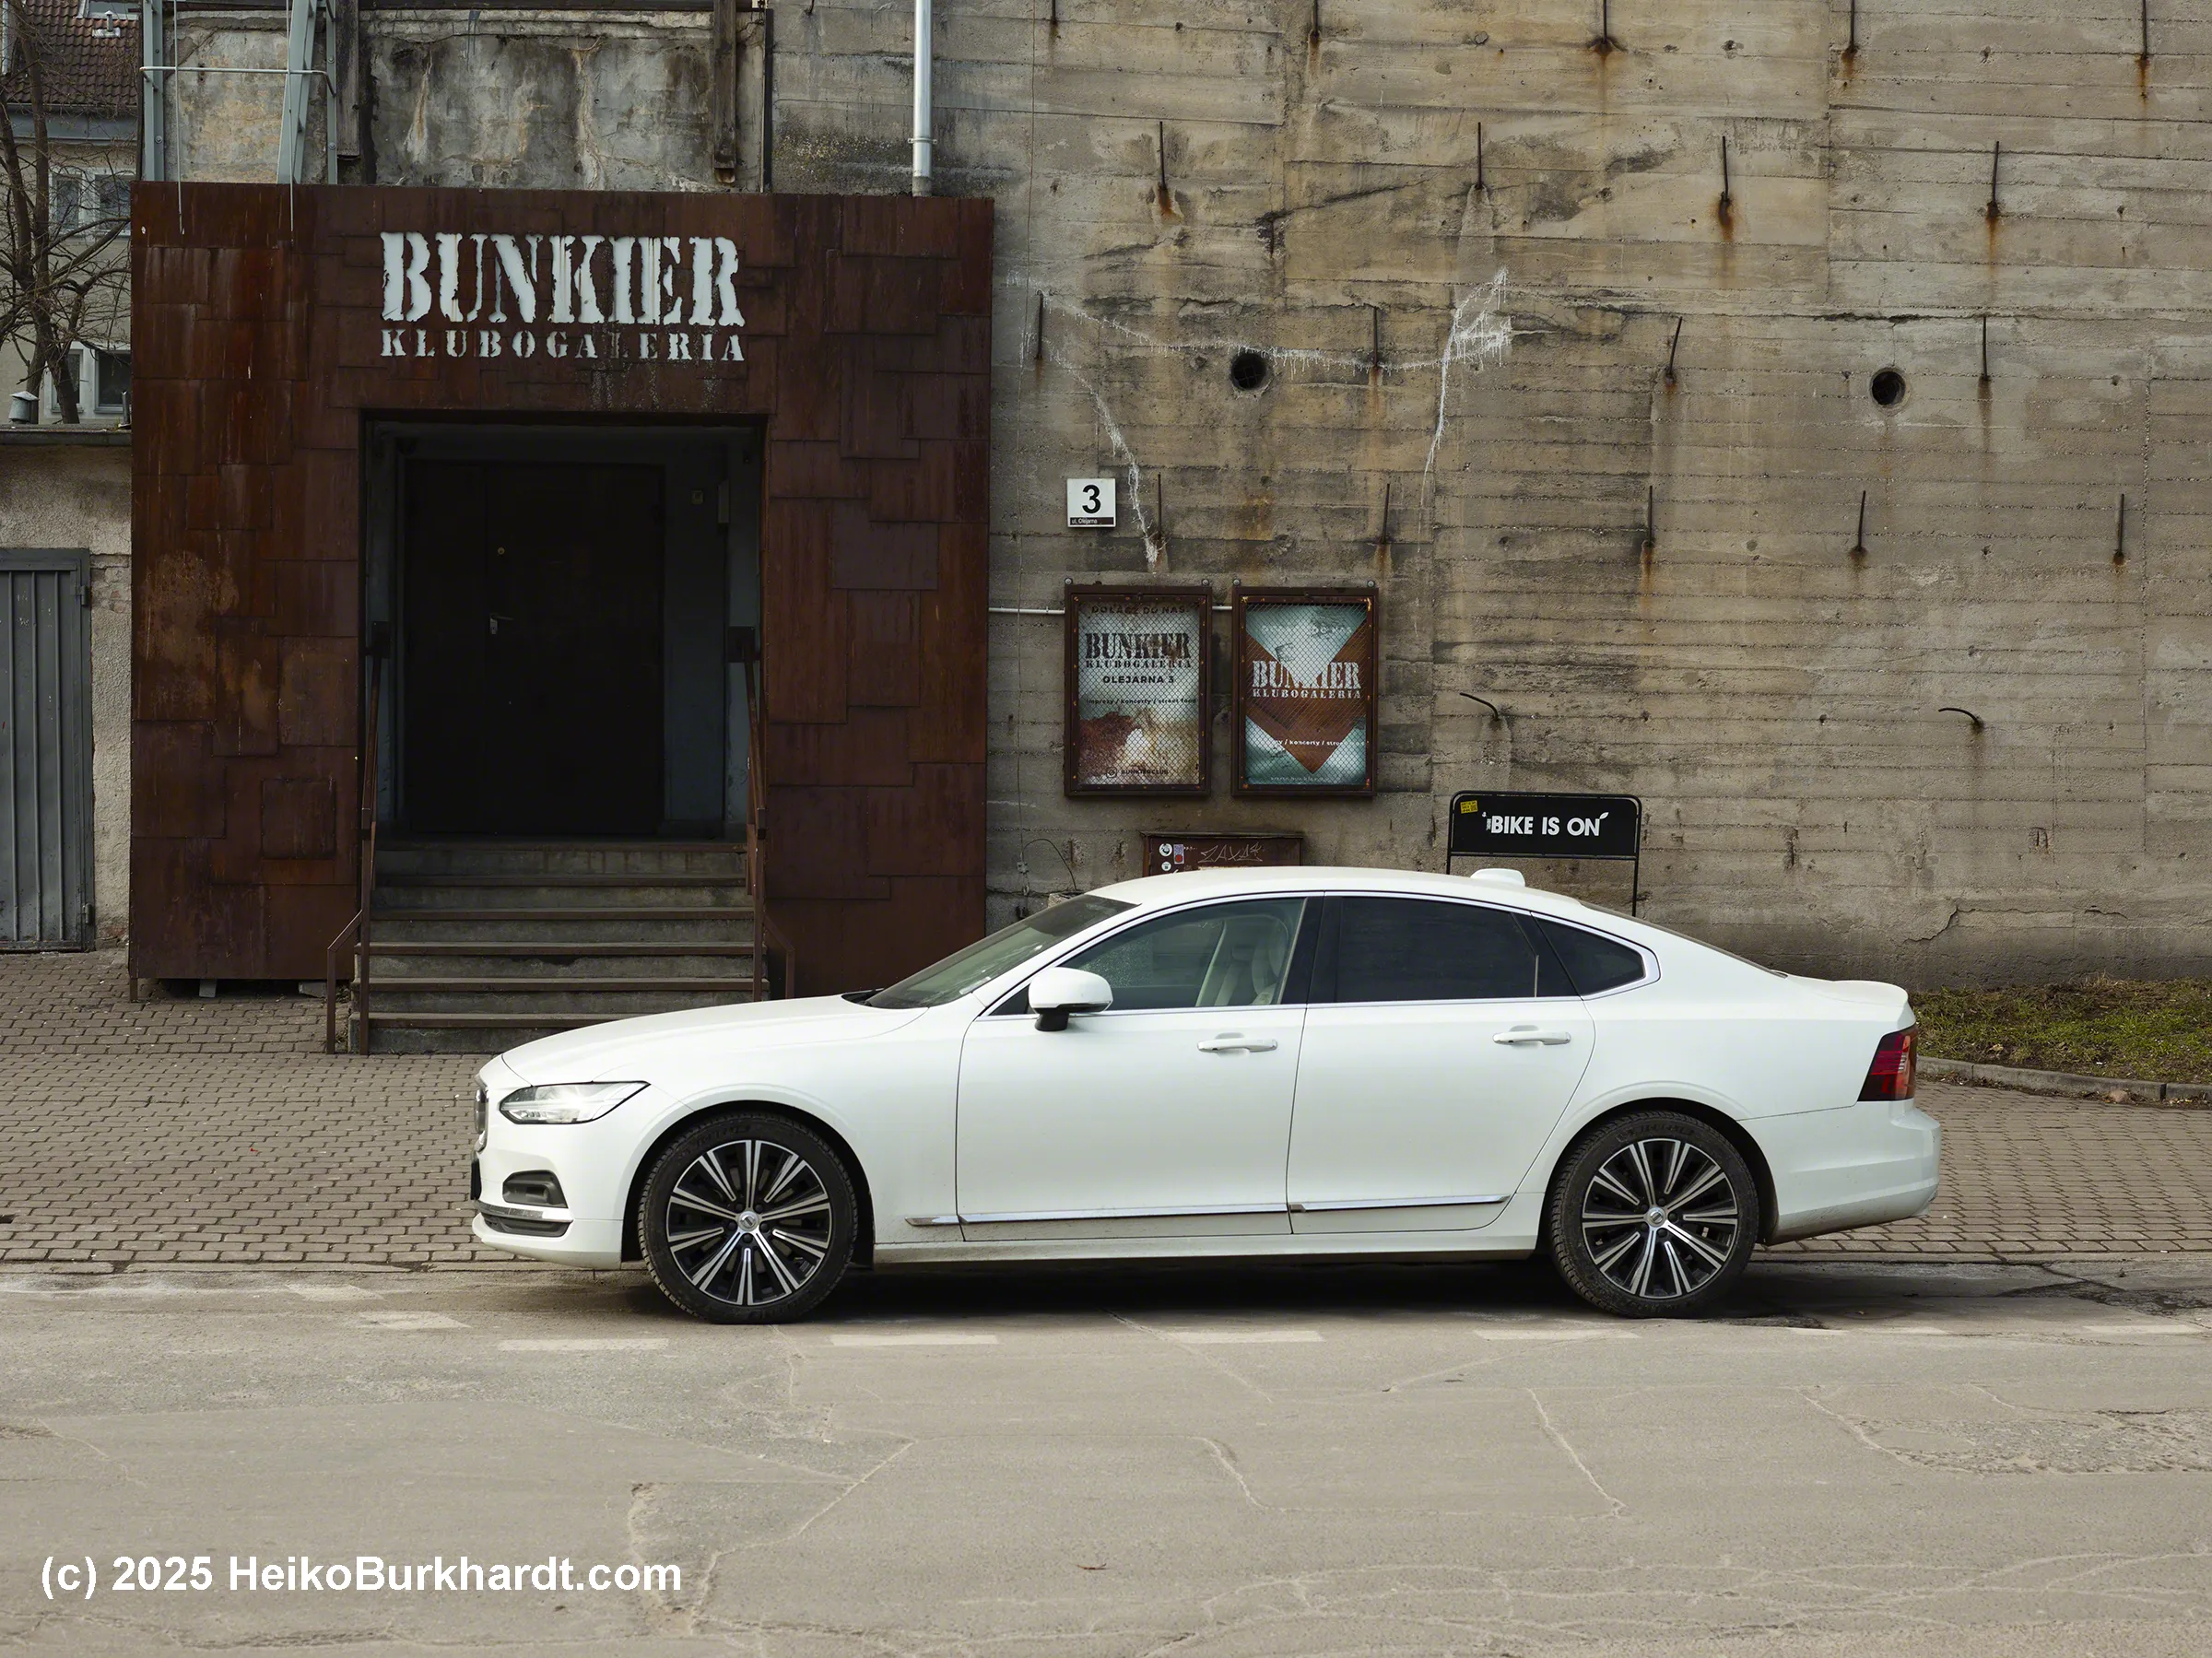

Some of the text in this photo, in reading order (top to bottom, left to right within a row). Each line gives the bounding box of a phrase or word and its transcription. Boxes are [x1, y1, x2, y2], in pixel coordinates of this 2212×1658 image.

[380, 231, 745, 327] BUNKIER
[381, 328, 745, 361] KLUBOGALERIA
[1082, 485, 1101, 514] 3
[1085, 632, 1192, 659] BUNKIER
[1102, 676, 1175, 684] OLEJARNA 3
[1252, 660, 1361, 689] BUNIER
[1253, 688, 1361, 699] KLUBOGALERIA
[1541, 817, 1559, 836] IS
